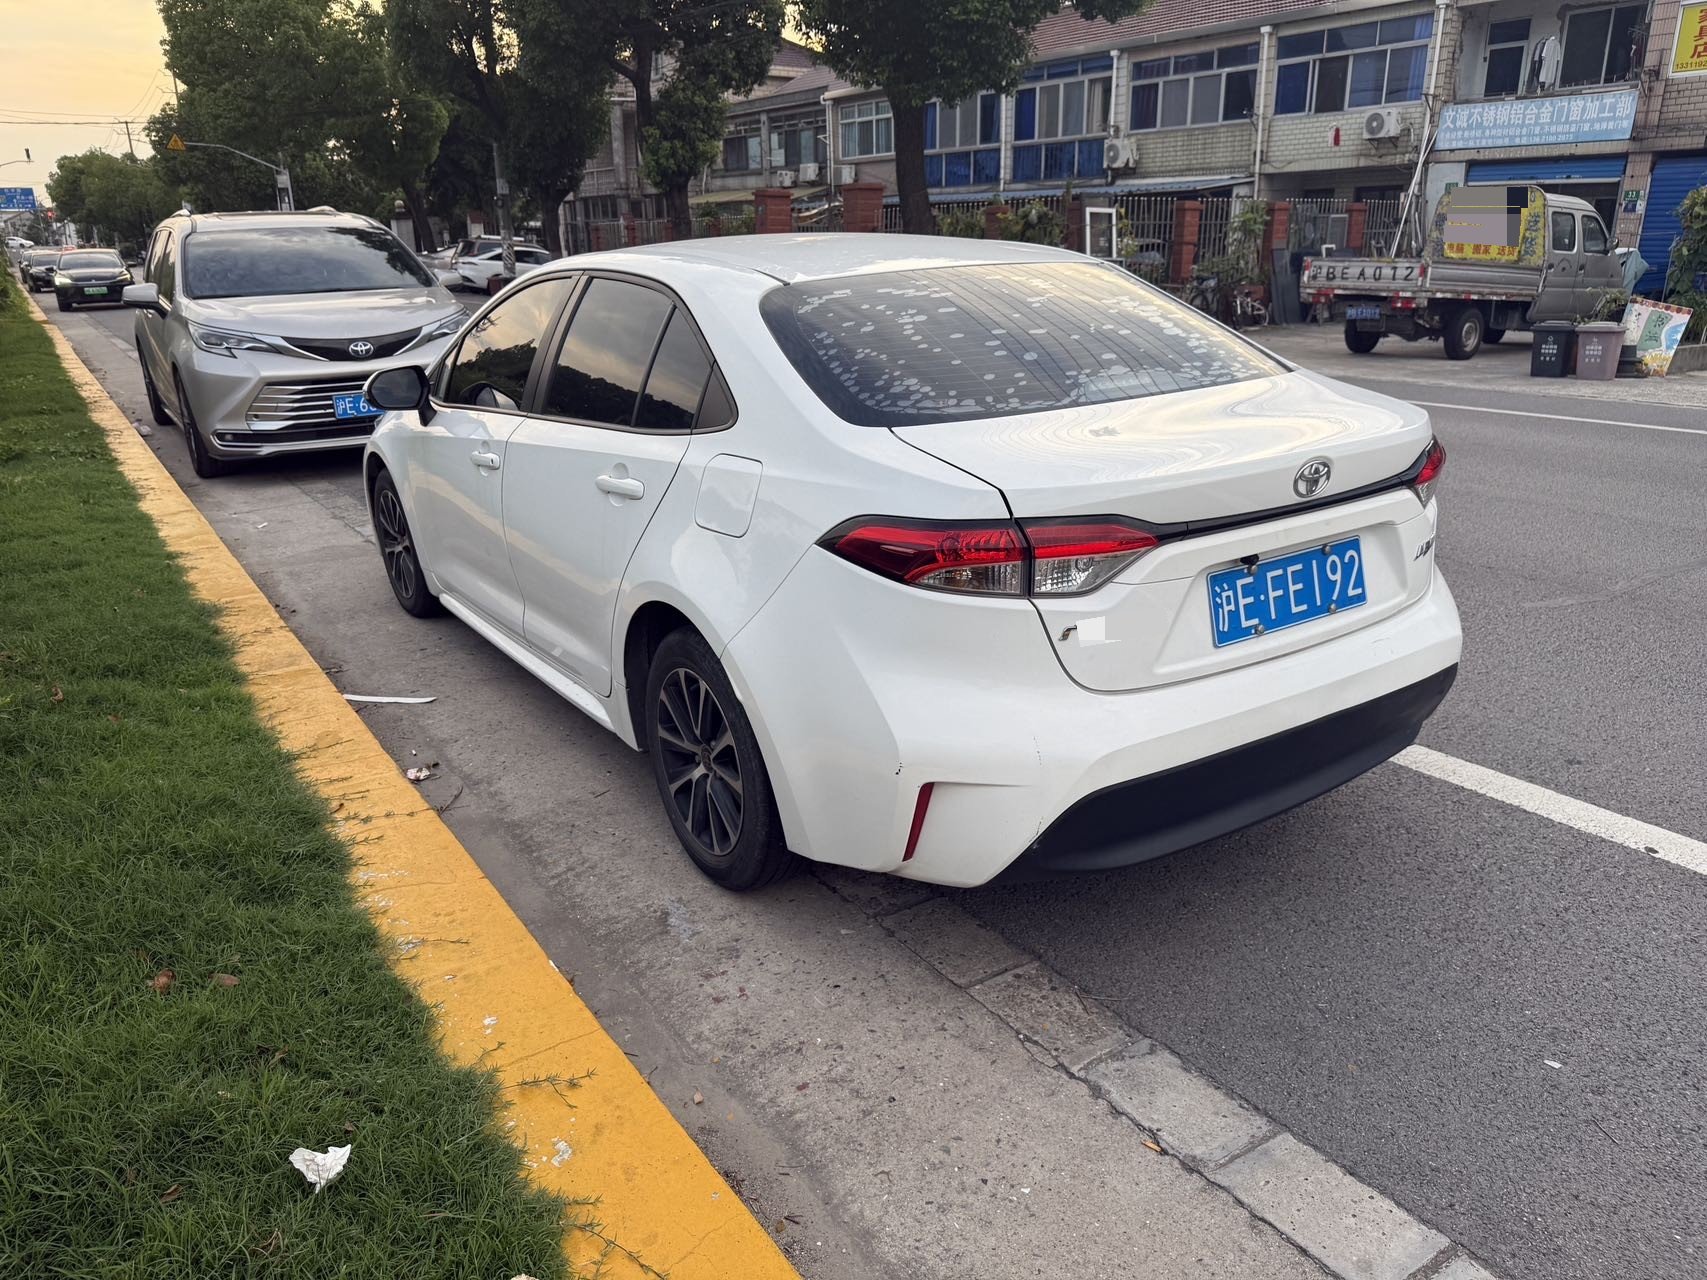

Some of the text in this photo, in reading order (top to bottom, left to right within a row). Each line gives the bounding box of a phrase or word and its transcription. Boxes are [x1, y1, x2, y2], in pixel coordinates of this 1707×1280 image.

[1442, 95, 1632, 129] 文诚不锈钢铝合金门窗加工部
[1214, 549, 1363, 632] 沪E·FE192
